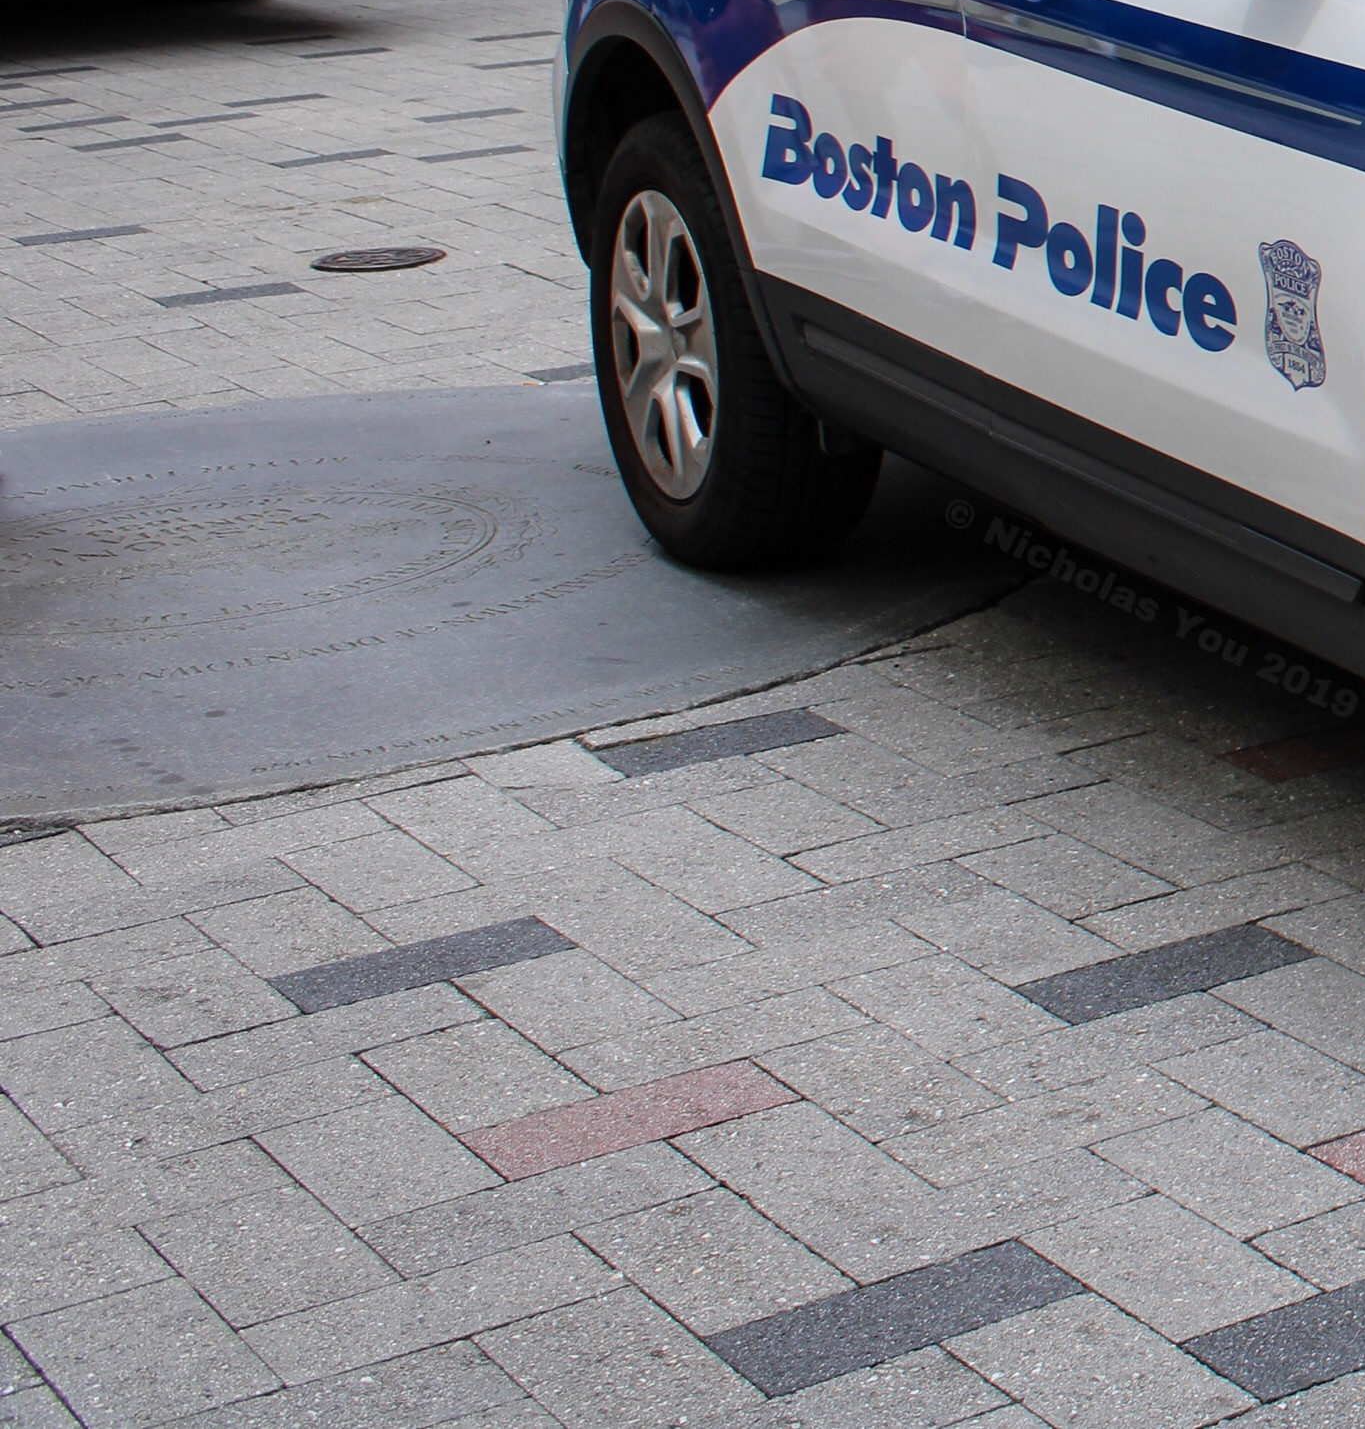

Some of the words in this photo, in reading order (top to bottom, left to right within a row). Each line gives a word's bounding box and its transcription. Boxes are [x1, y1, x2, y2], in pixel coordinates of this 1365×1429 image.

[761, 93, 977, 252] Boston
[992, 173, 1238, 354] Police
[1270, 246, 1310, 273] BOSTON
[1274, 274, 1308, 296] POLICE
[1287, 358, 1306, 374] 1854
[138, 634, 387, 681] DOWNTOWN
[458, 720, 522, 740] NEW
[326, 735, 450, 761] BOSTON
[250, 758, 312, 774] 1979
